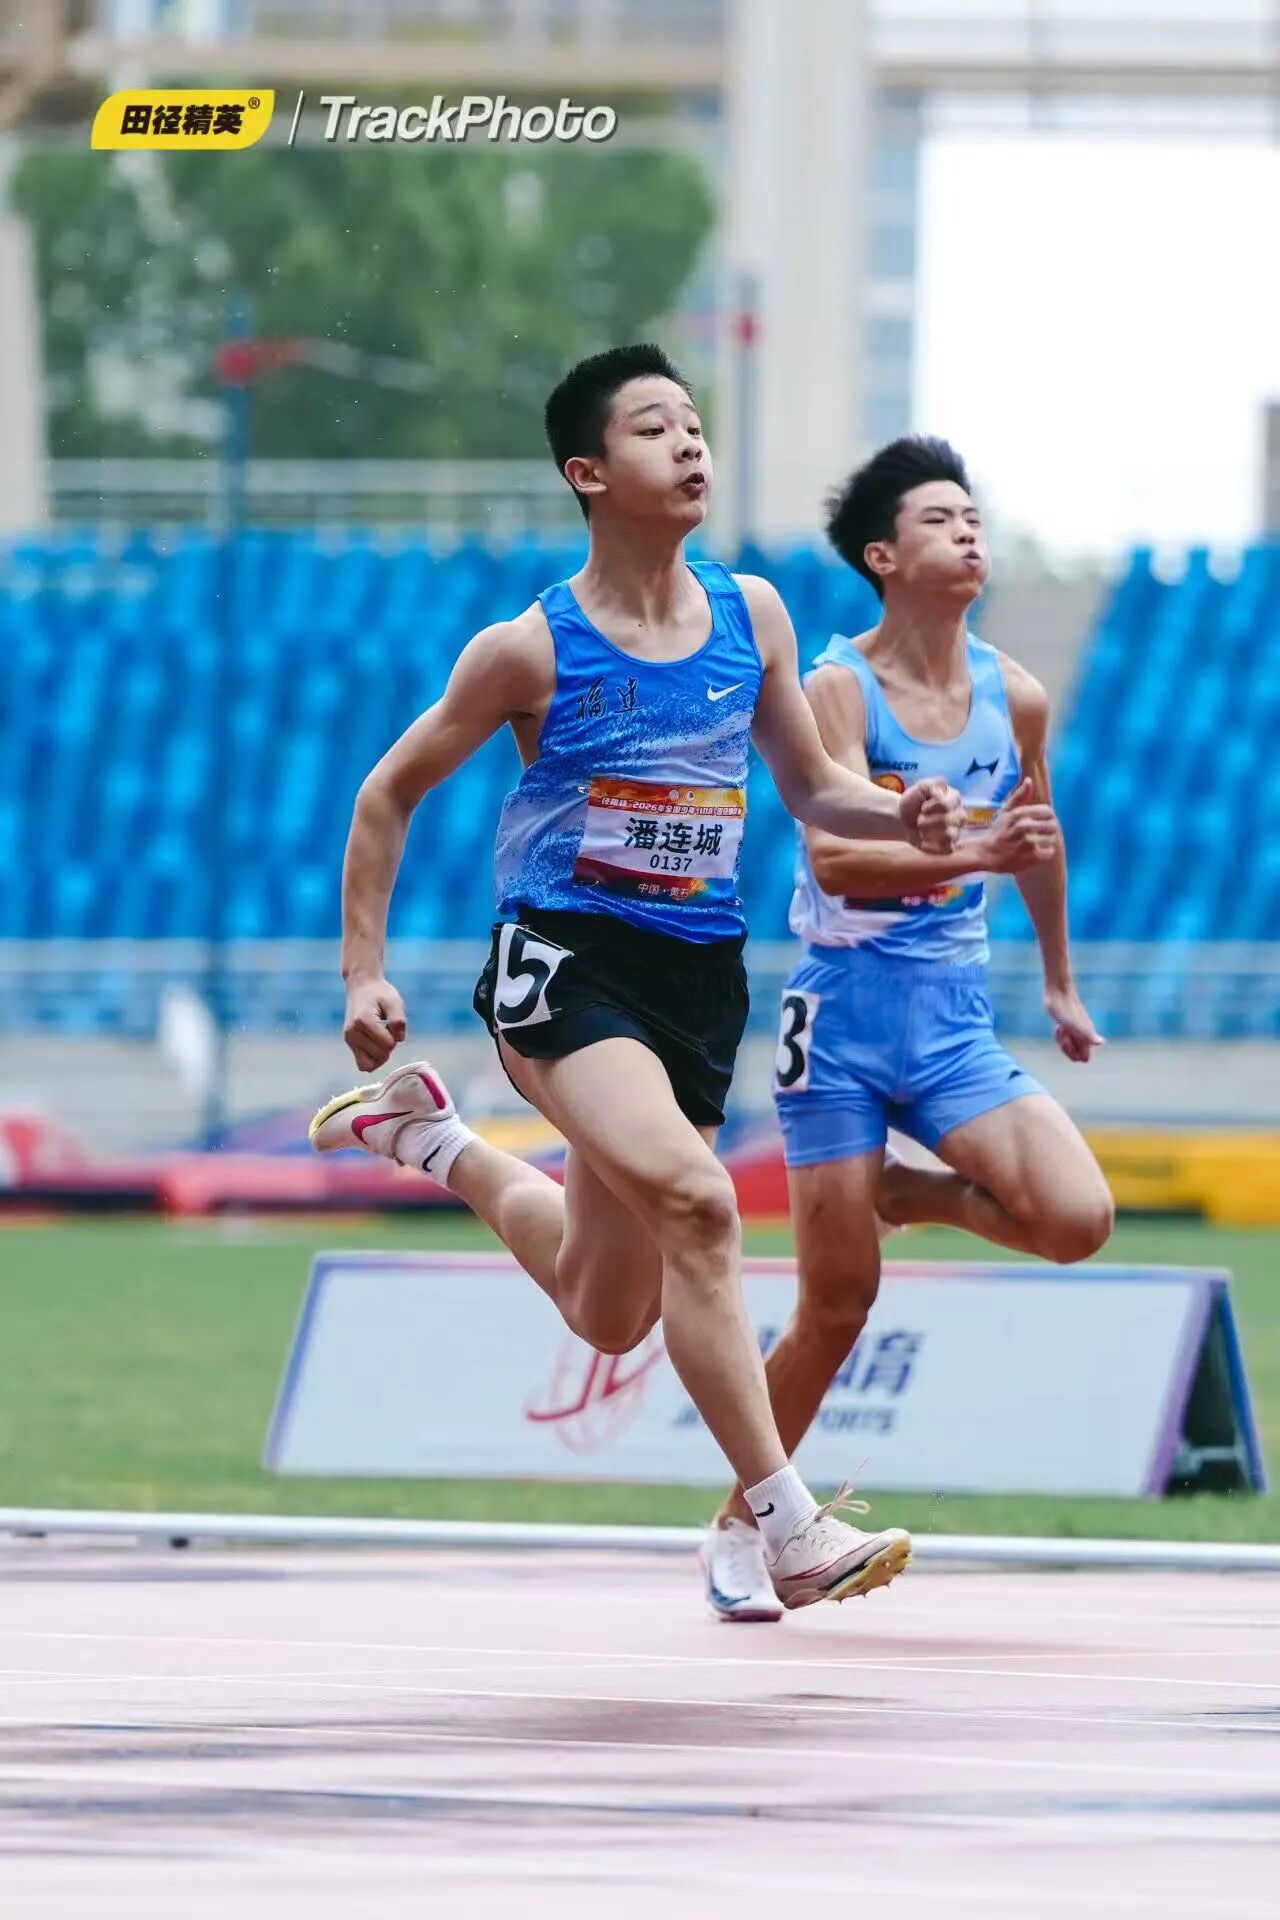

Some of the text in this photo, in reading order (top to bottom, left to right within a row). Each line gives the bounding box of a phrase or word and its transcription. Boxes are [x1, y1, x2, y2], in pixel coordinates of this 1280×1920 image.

[624, 817, 723, 857] 潘连城
[649, 854, 693, 872] 0137
[496, 925, 550, 1024] 5
[777, 995, 808, 1087] 3
